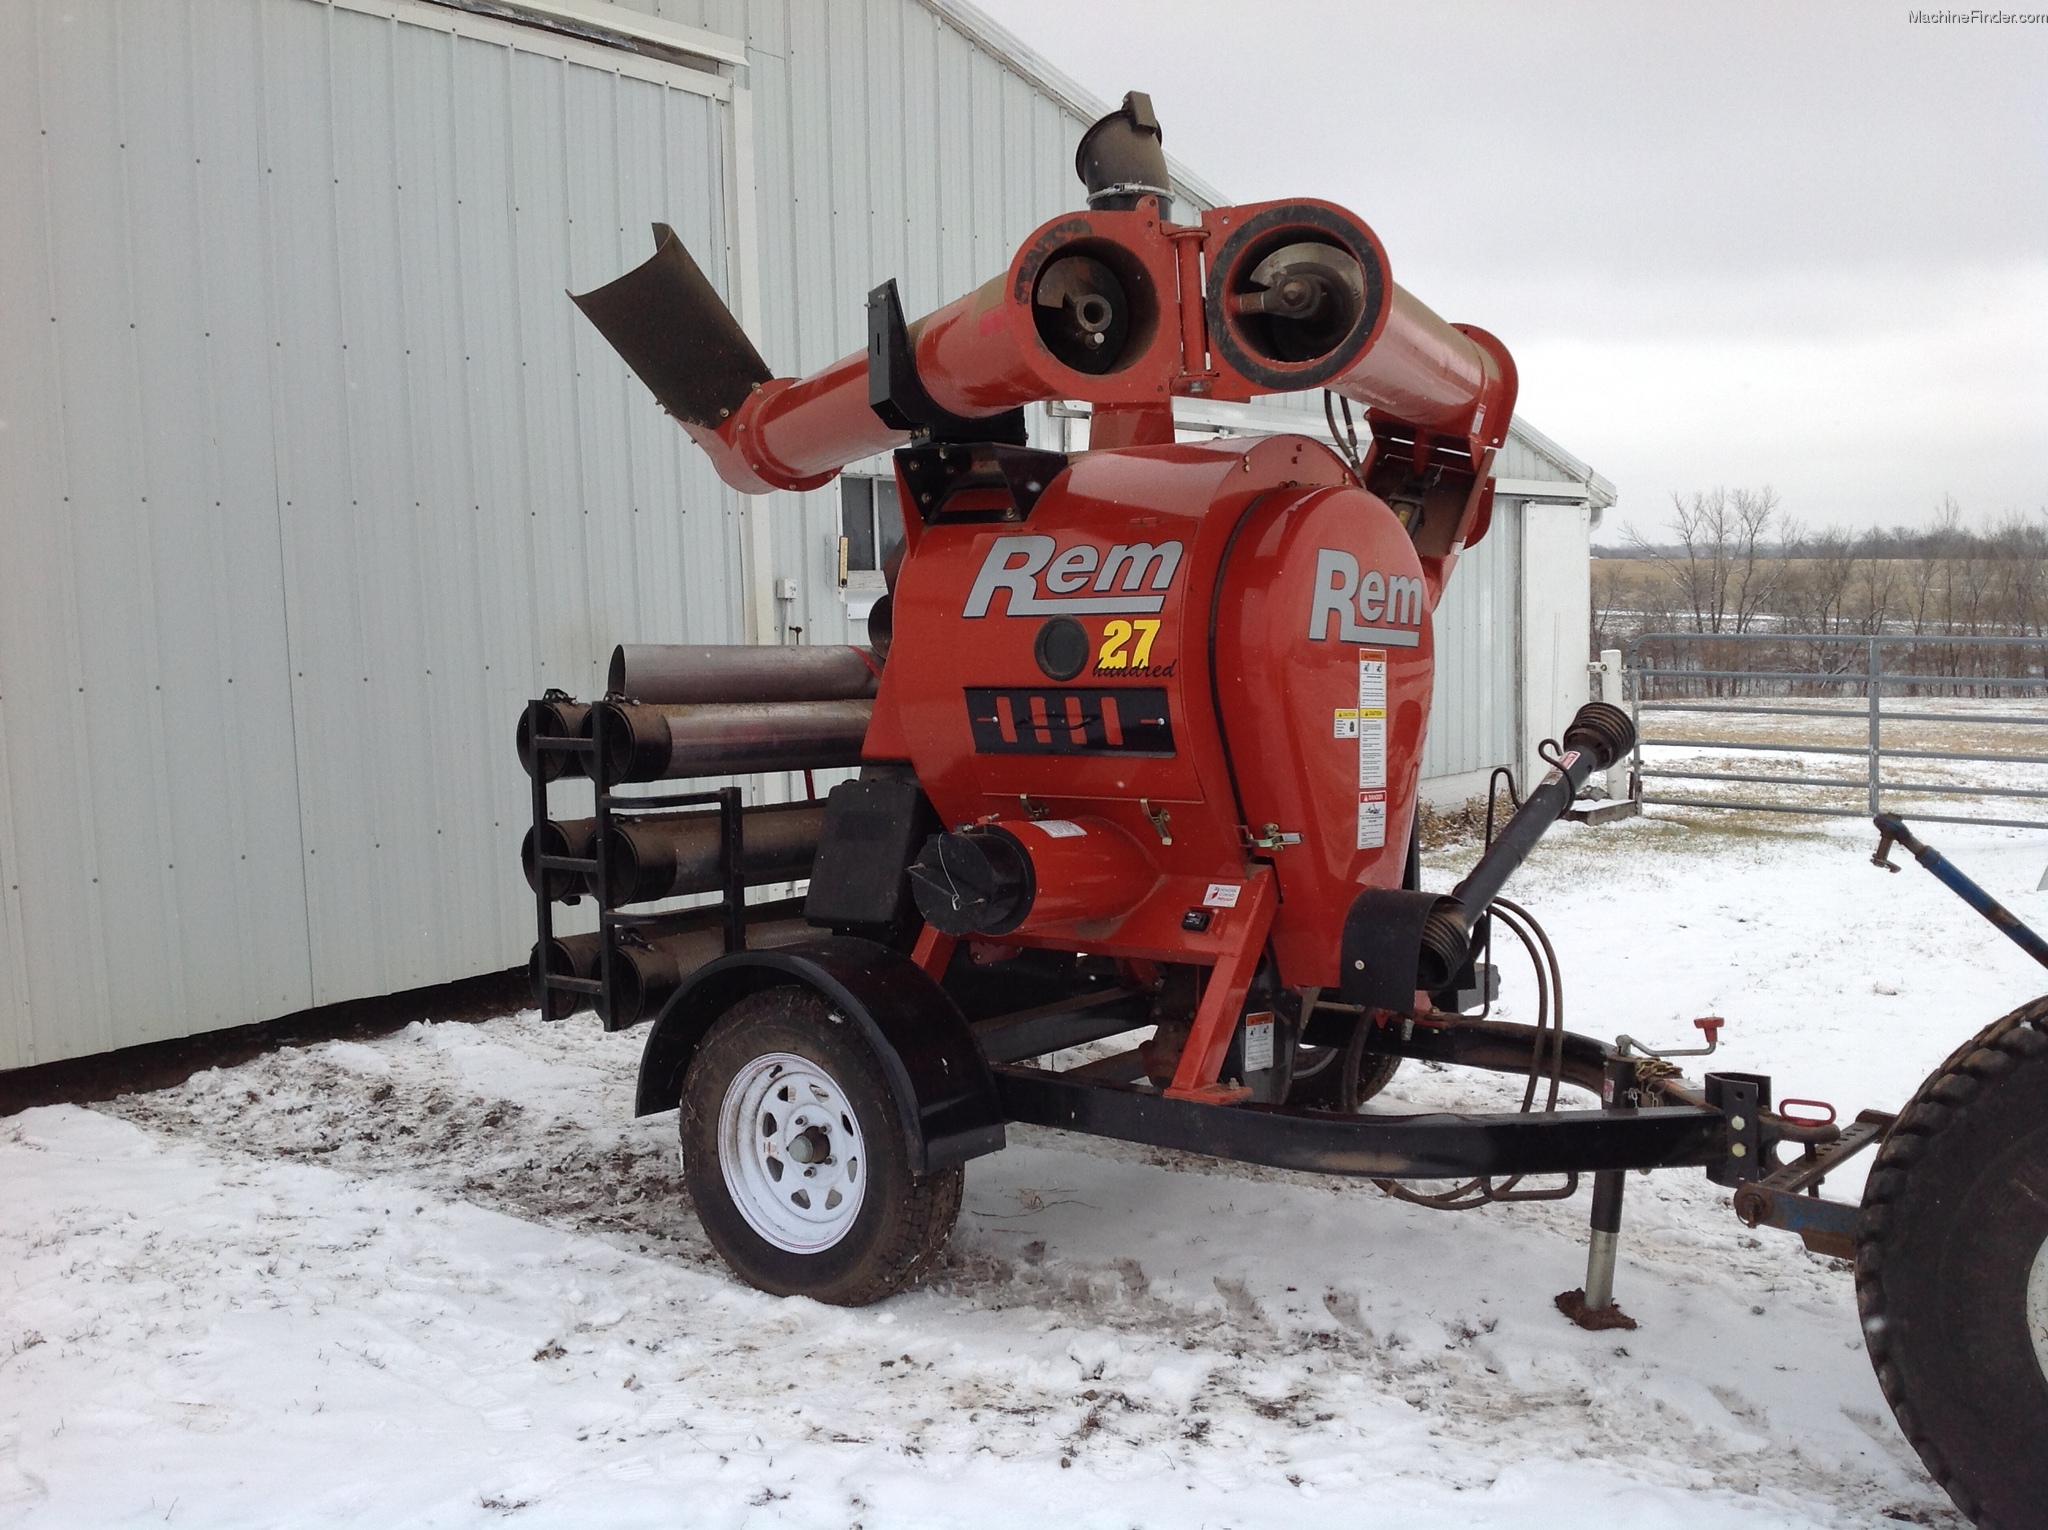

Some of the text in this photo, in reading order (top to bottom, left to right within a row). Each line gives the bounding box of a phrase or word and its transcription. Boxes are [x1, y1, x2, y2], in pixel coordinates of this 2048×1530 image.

[962, 535, 1184, 618] Rem
[1308, 547, 1423, 648] Rem
[1092, 657, 1177, 678] hundred
[1098, 619, 1161, 669] 27
